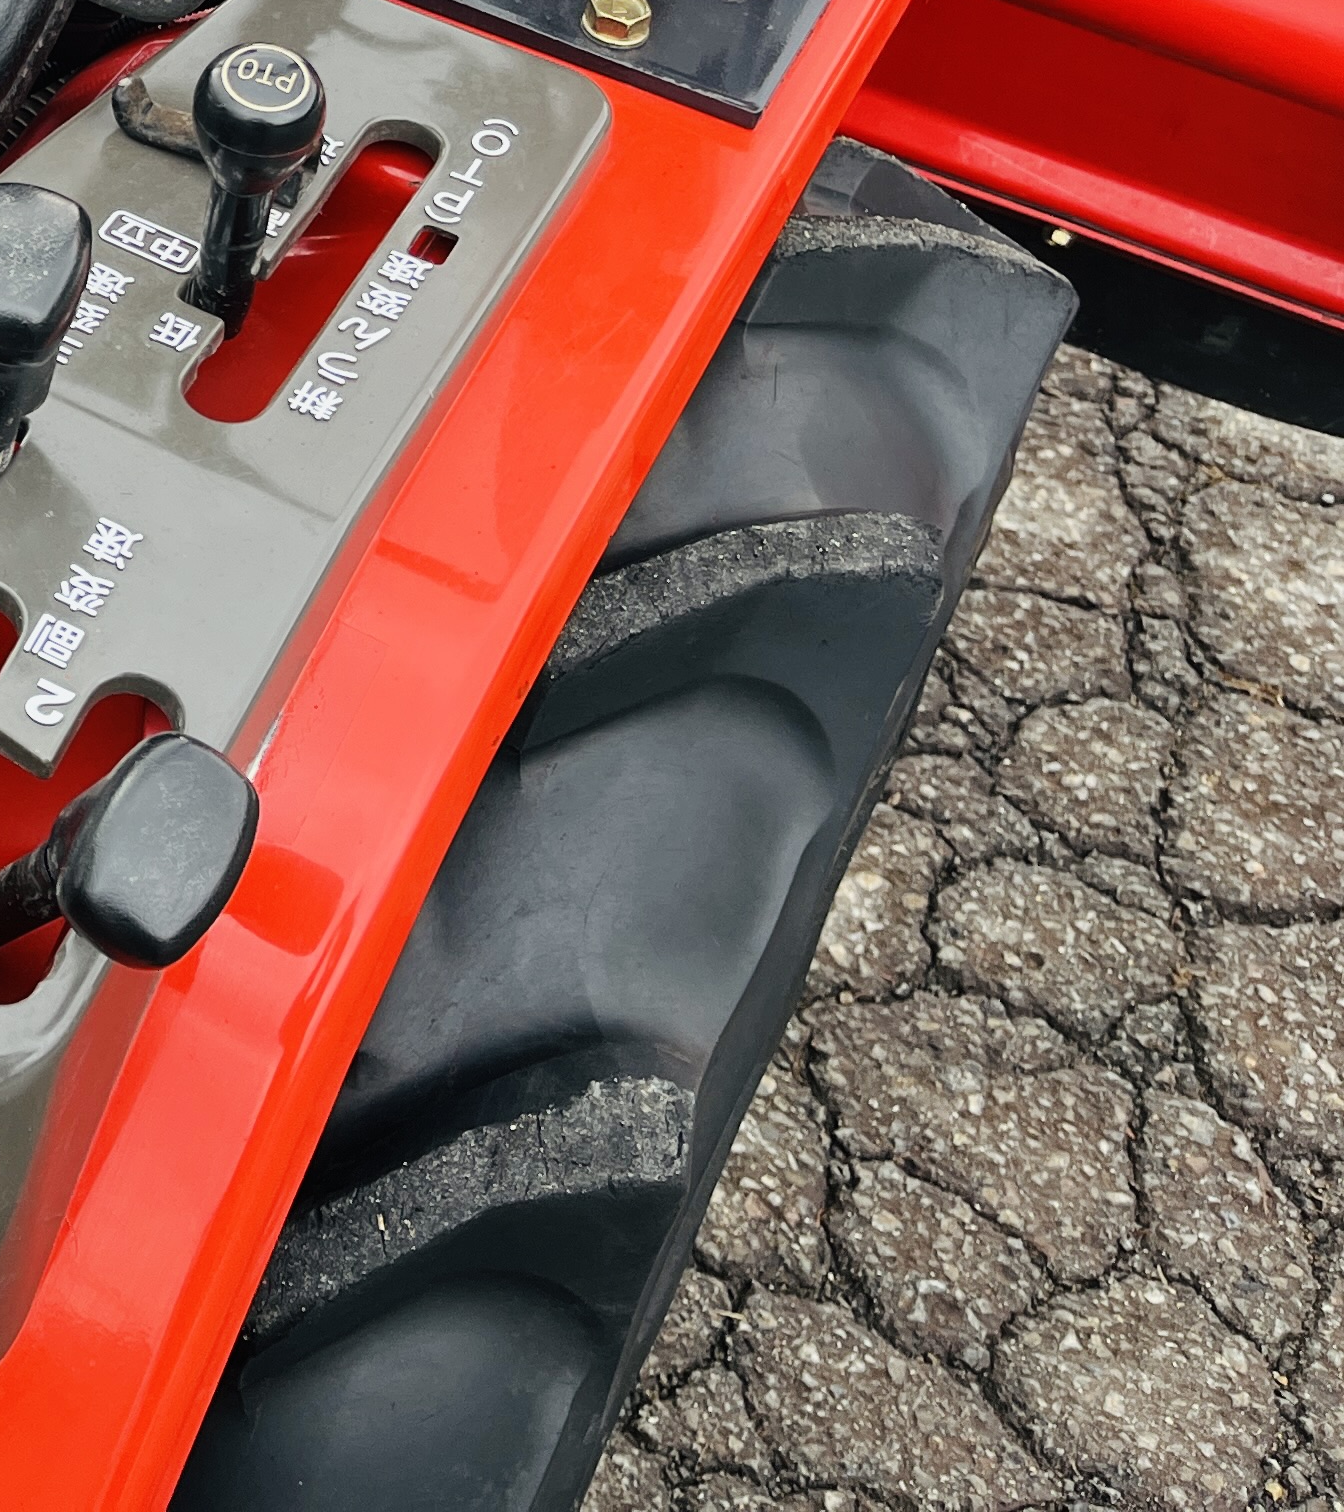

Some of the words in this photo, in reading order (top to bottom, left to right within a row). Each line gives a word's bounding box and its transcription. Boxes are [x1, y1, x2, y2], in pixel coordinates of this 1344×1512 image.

[237, 58, 298, 94] PTO
[108, 216, 199, 267] 中立
[146, 312, 202, 356] 低
[286, 248, 433, 422] 耕うん変速
[22, 515, 146, 673] 副変速
[22, 689, 79, 729] 2
